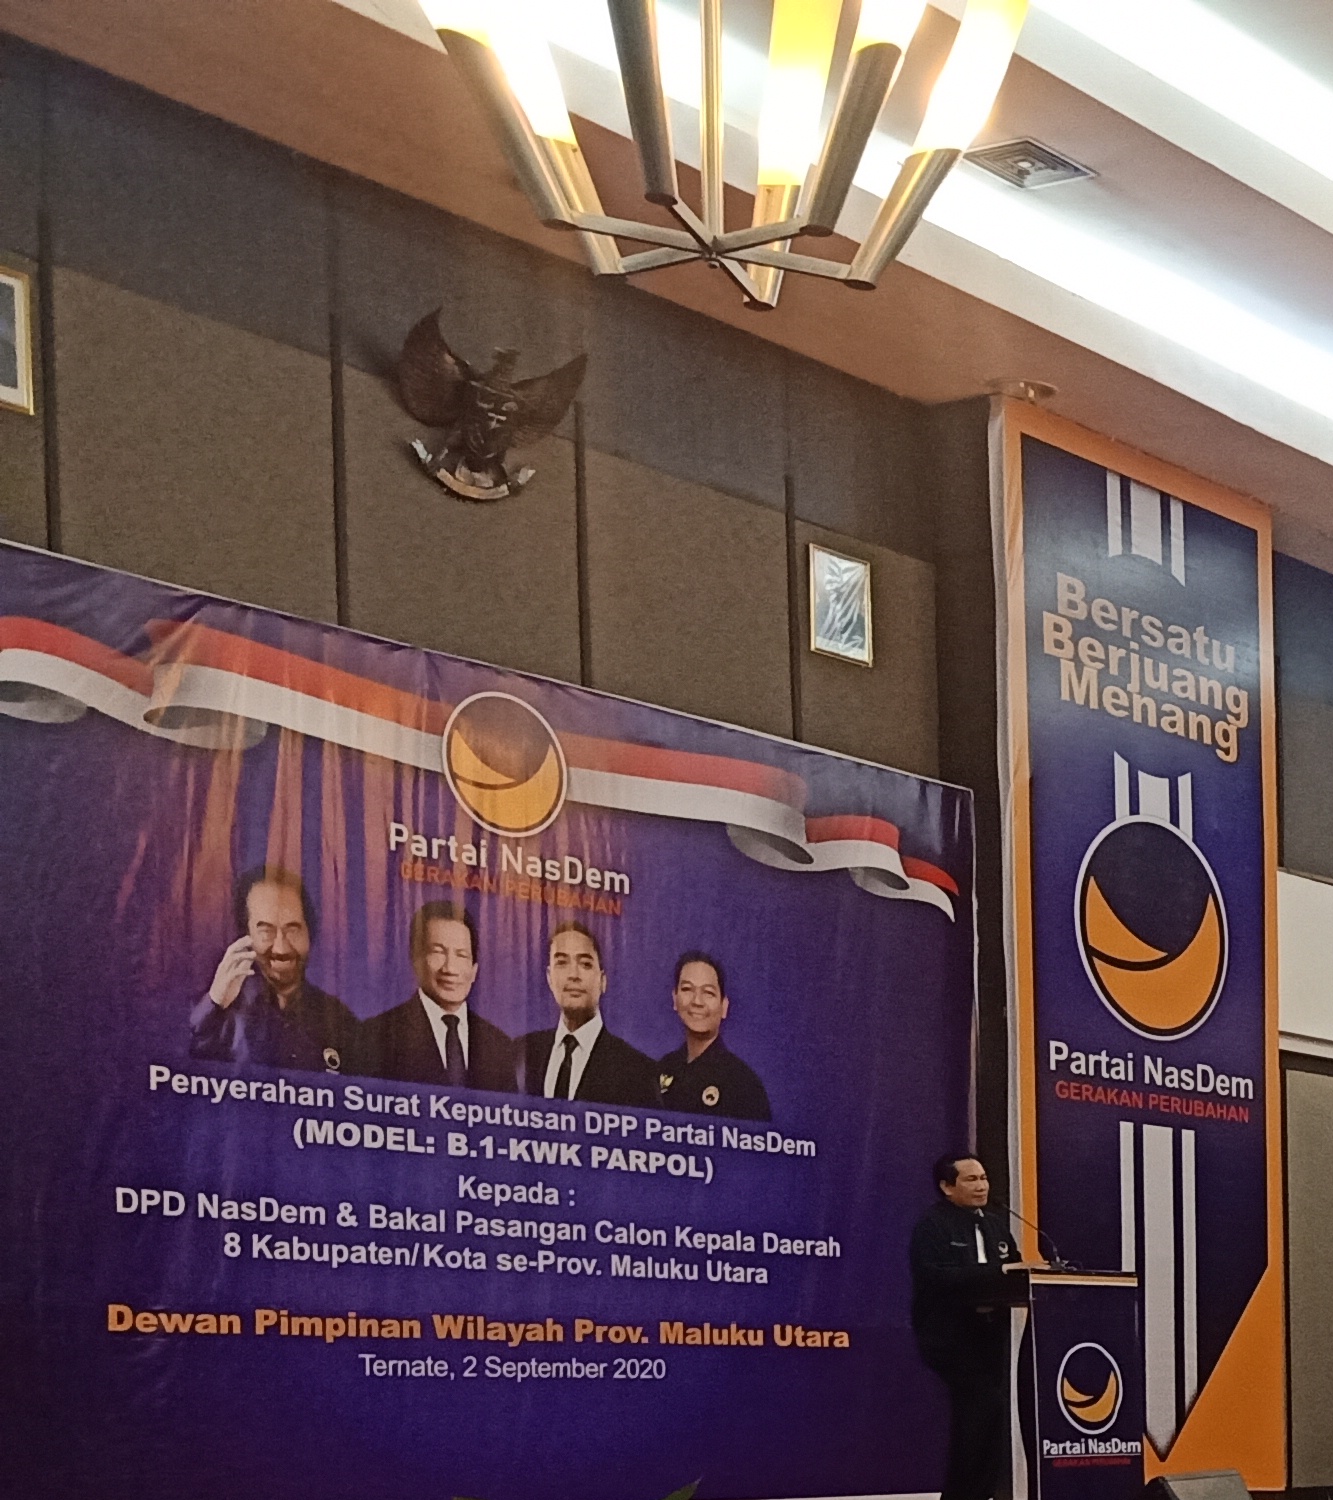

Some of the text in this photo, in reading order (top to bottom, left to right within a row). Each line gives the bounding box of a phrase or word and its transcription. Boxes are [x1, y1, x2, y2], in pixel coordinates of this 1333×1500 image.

[1056, 572, 1235, 674] Bersatu
[1042, 610, 1249, 729] Berjuang
[1059, 658, 1239, 763] Menang
[389, 822, 631, 894] Partai NasDem
[400, 861, 497, 894] GERAKAN
[1049, 1040, 1254, 1100] Partai NasDem
[148, 1064, 817, 1158] Penyerahan Surat Keputusan DPP Partai NasDem
[1055, 1079, 1250, 1123] GERAKAN PERUBAHAN
[293, 1117, 715, 1184] (MODEL: B.1-KWK PARPOL)
[458, 1174, 560, 1208] Kepada
[115, 1186, 842, 1258] DPD NasDem & Bakal Pasangan Calon Kepala Daerah
[223, 1232, 242, 1258] 8
[496, 1249, 602, 1276] se-Prov.
[610, 1253, 699, 1281] Maluku
[706, 1259, 769, 1284] Utara
[107, 1303, 851, 1349] Dewan Pimpinan Wilayah Prov. Maluku Utara
[358, 1352, 667, 1383] Ternate, 2 September 2020
[1042, 1437, 1142, 1456] Partai NasDem
